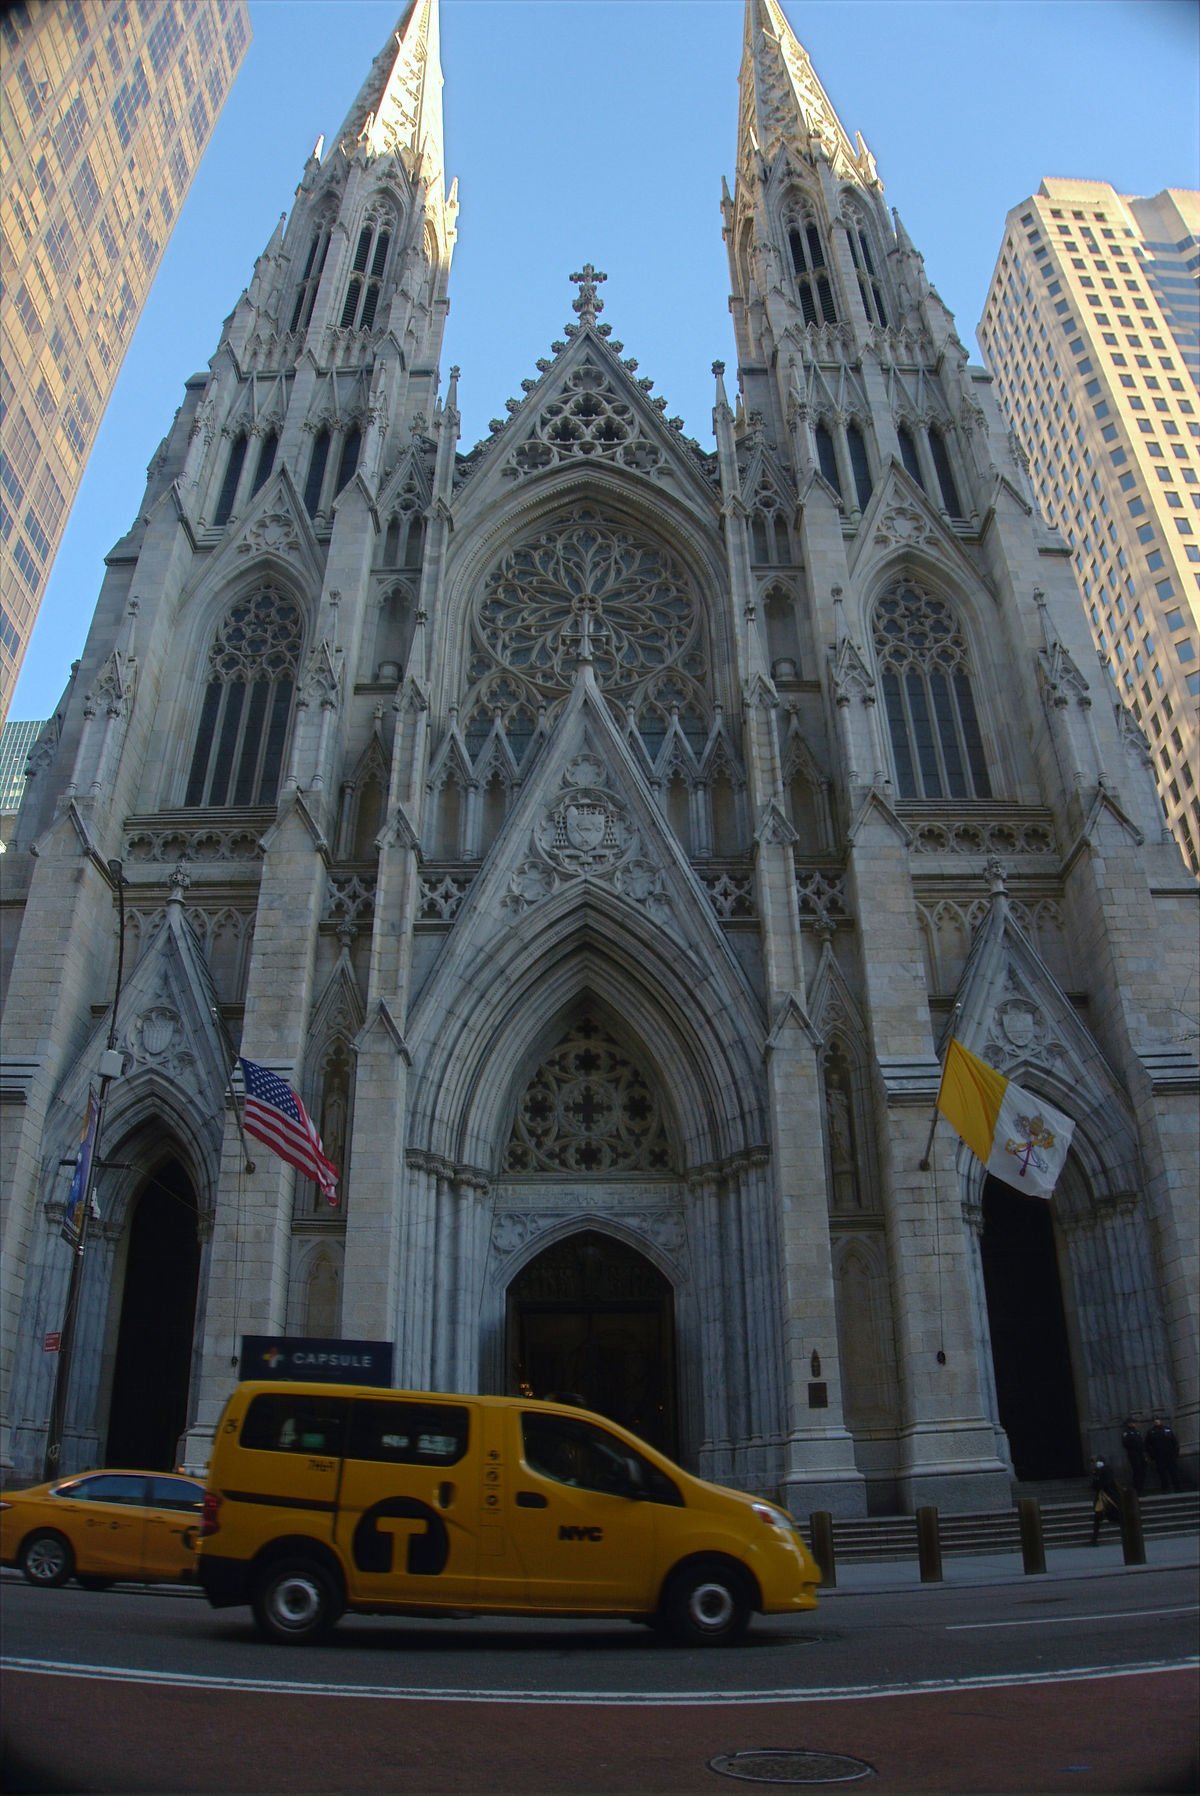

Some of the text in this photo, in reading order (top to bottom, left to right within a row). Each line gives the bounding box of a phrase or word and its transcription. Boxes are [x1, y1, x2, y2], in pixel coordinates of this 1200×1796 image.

[292, 1352, 372, 1367] CAPSULE
[559, 1525, 603, 1542] NYC
[375, 1516, 428, 1574] T
